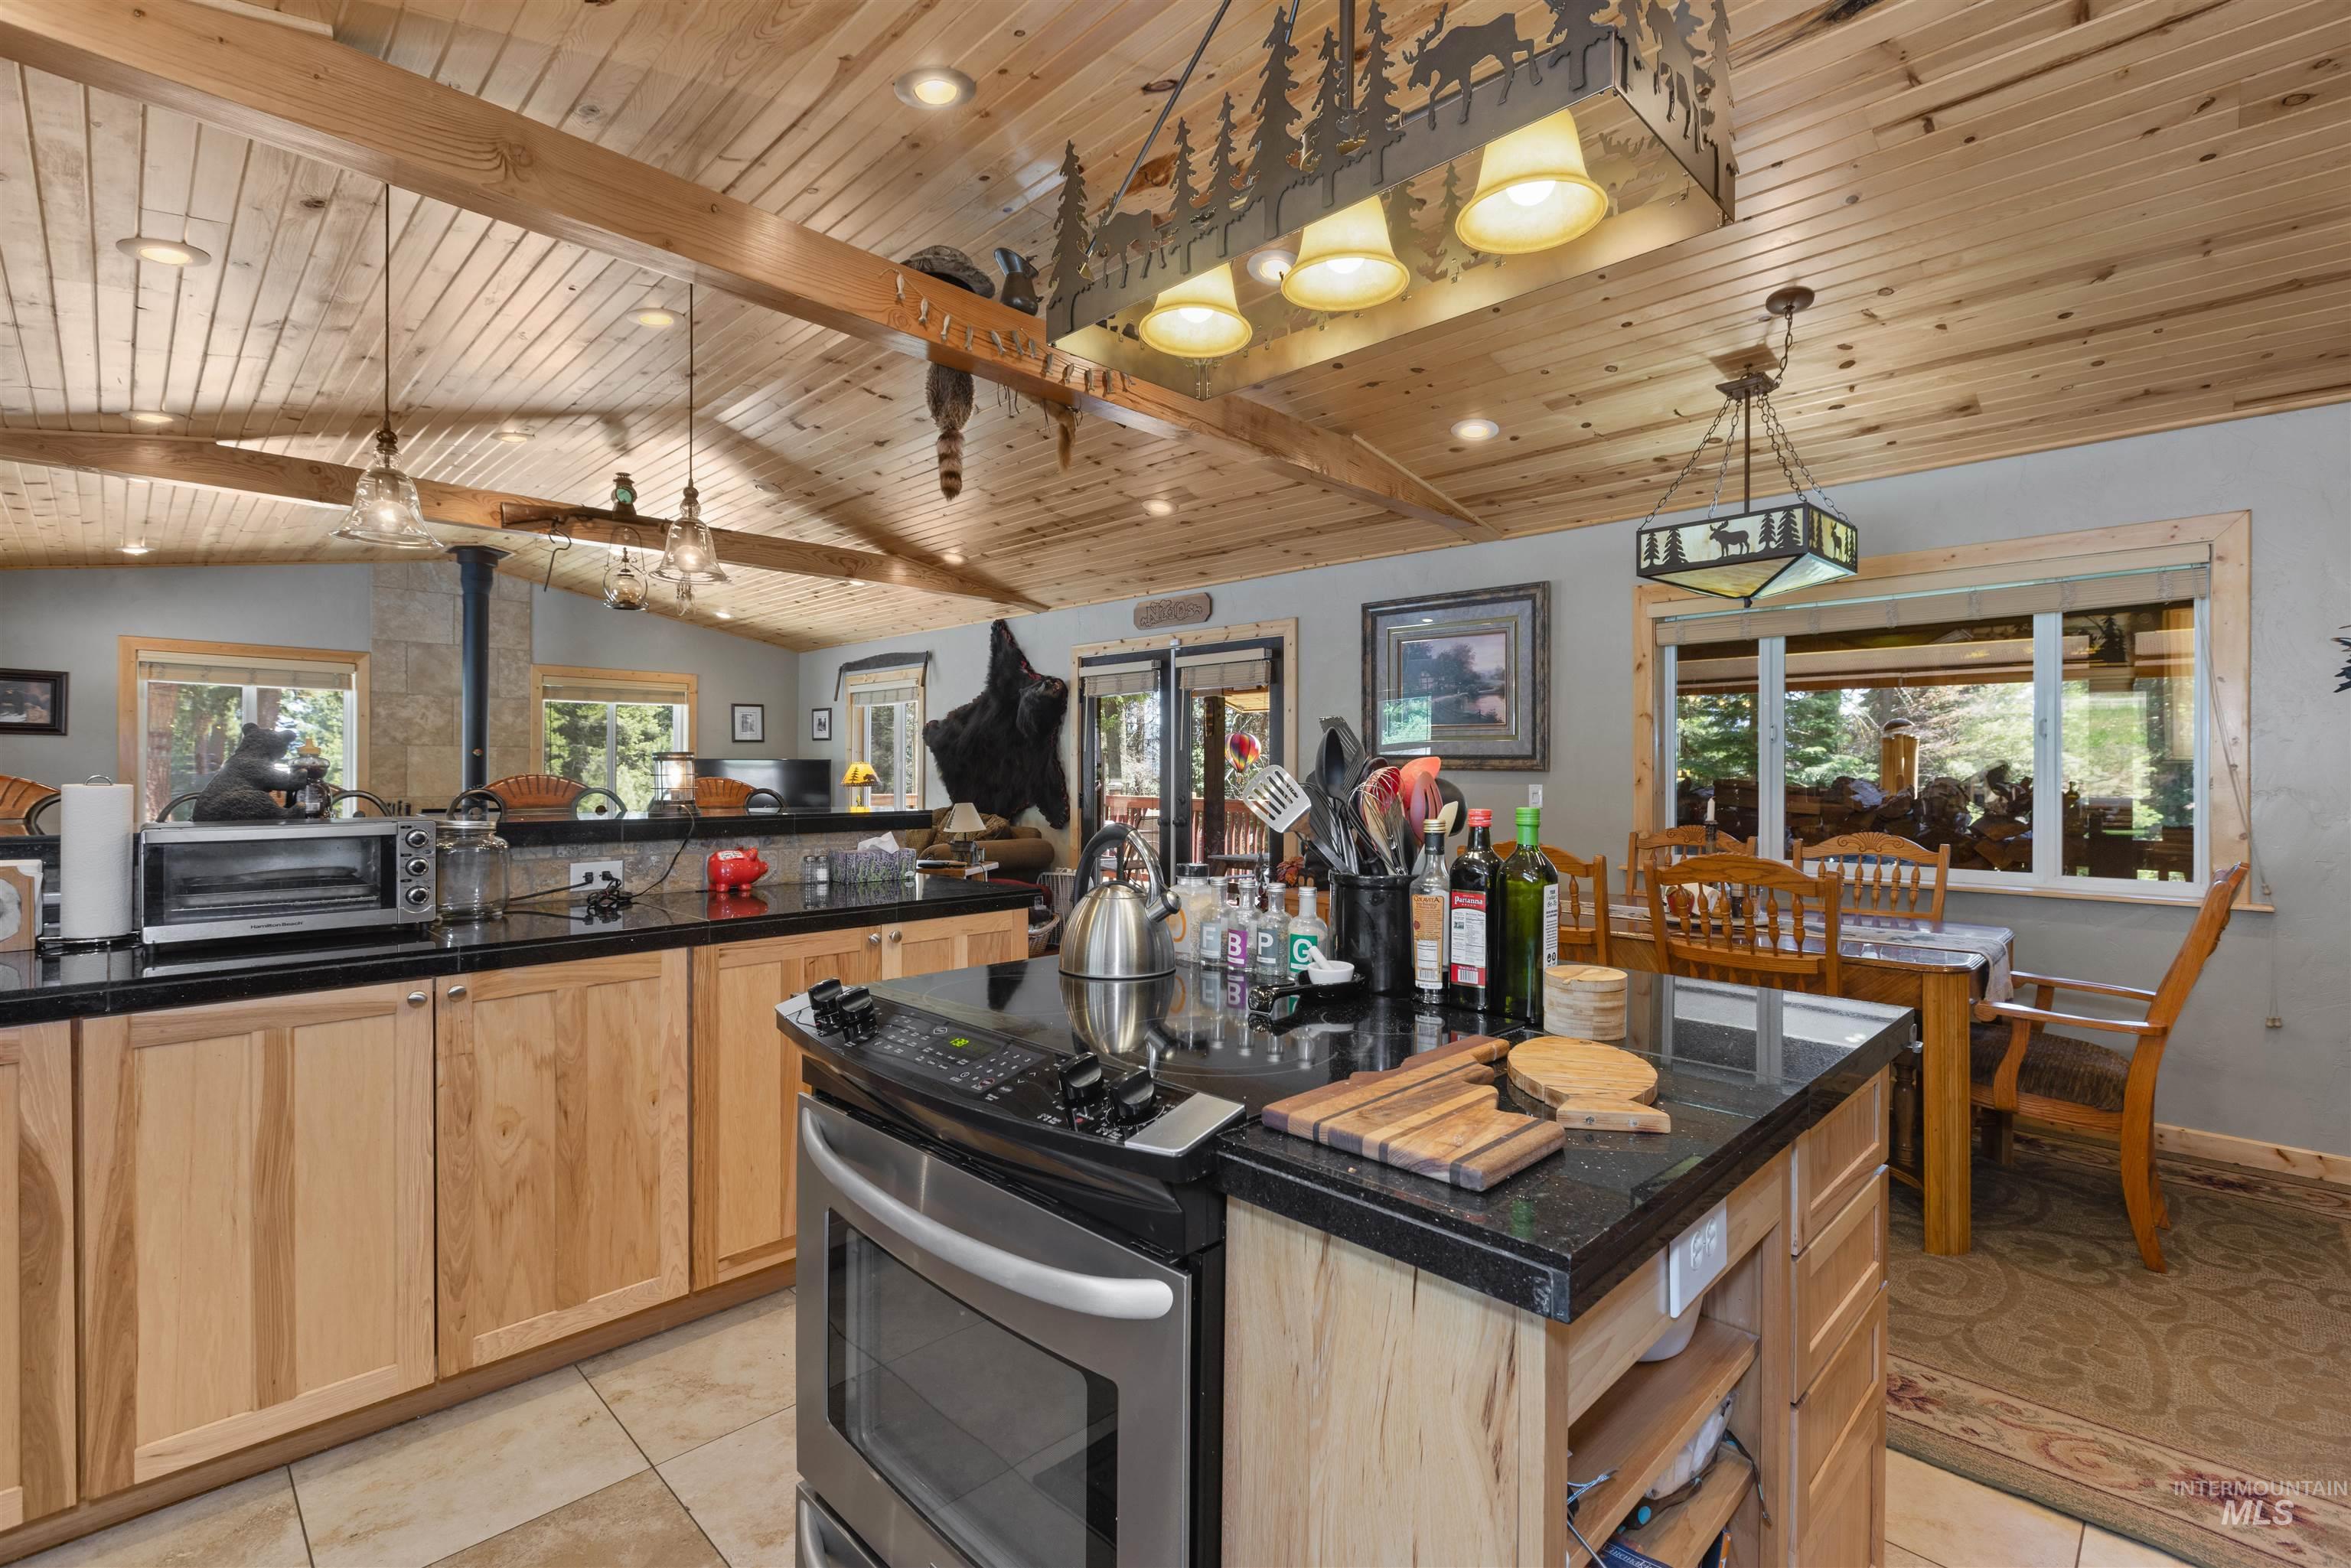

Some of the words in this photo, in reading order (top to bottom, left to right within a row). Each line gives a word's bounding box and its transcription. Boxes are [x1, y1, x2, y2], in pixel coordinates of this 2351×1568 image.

[1202, 926, 1215, 948] F
[1228, 932, 1241, 957] B
[1257, 932, 1273, 955] P
[1293, 938, 1312, 963] G
